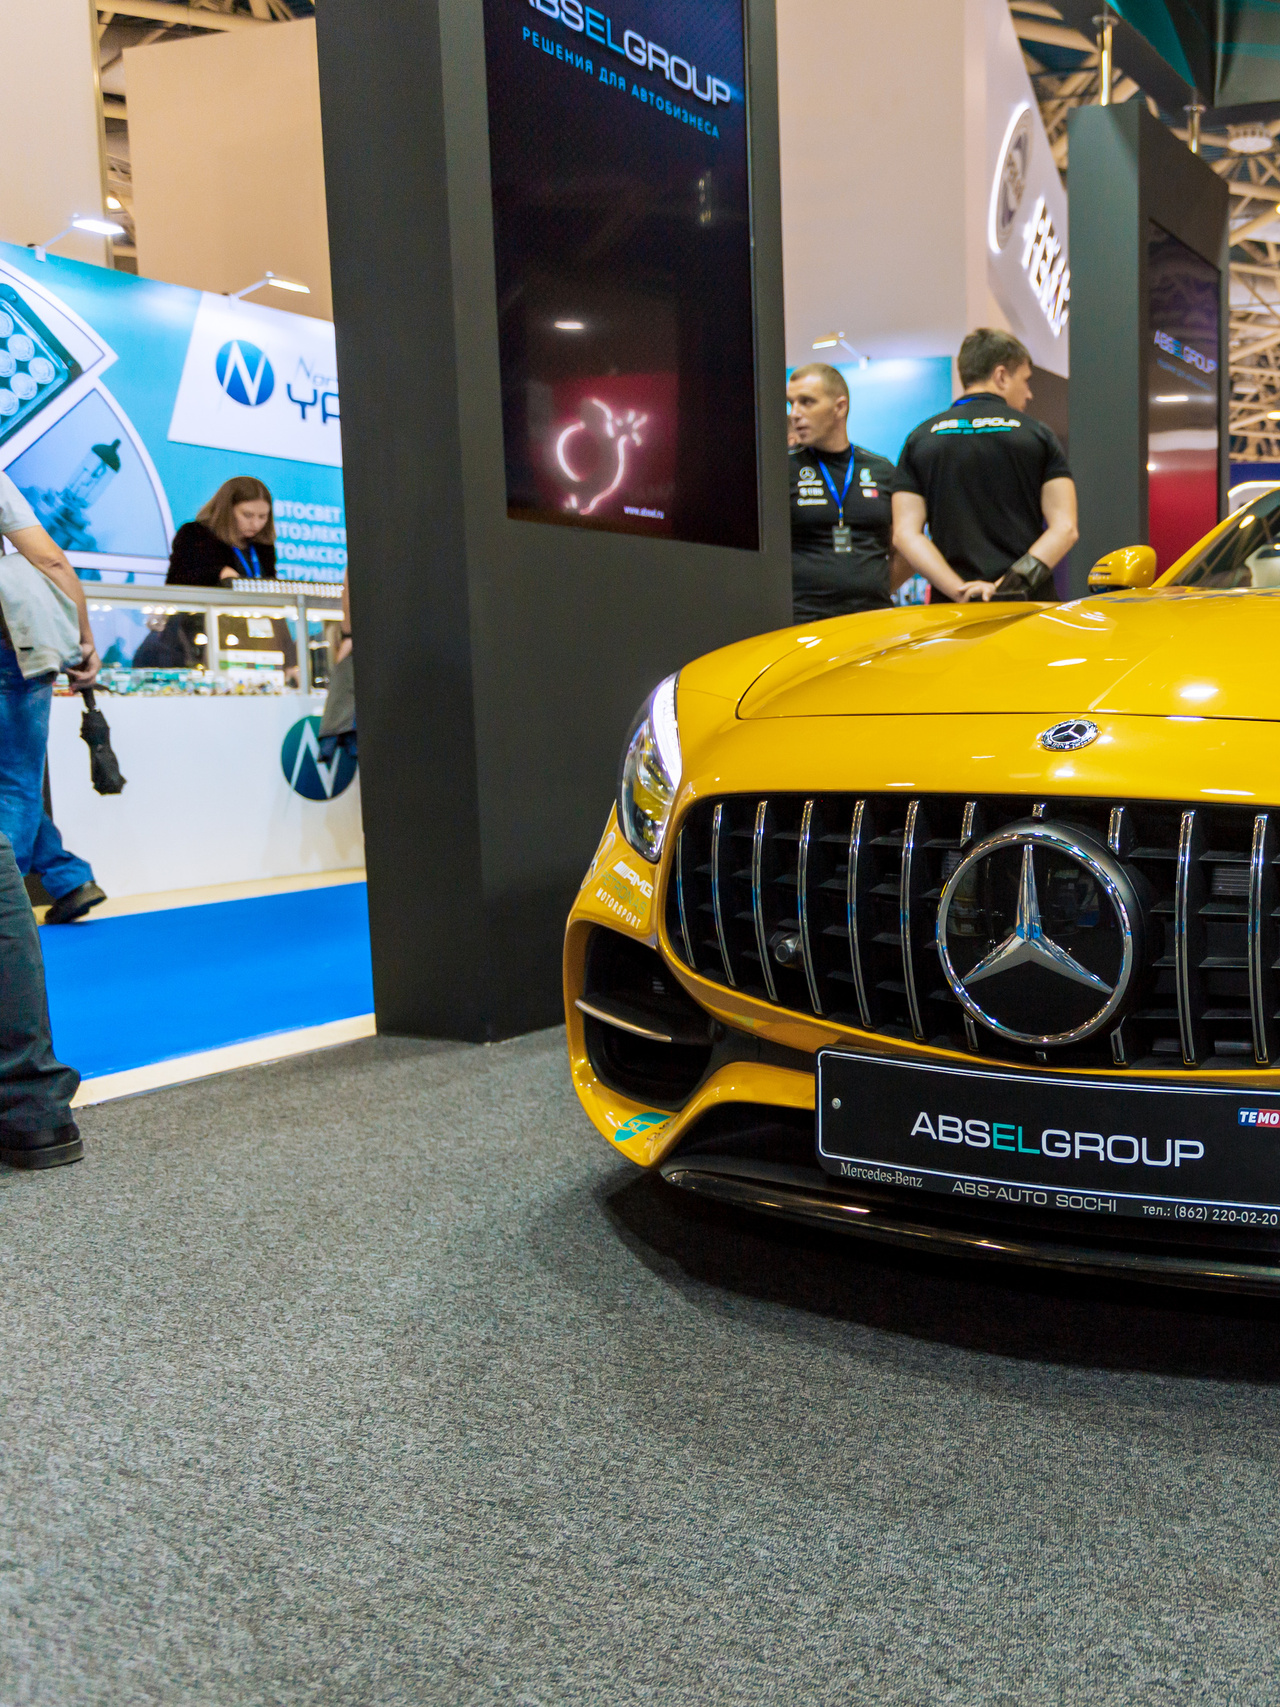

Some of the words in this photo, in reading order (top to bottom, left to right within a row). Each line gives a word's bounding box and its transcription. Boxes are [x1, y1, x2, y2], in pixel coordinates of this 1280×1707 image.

[528, 0, 731, 105] BSELGROUP
[522, 25, 593, 75] РЕШЕНИЯ
[599, 67, 626, 92] ДЛЯ
[631, 84, 720, 139] АВТОБИЗНЕСА
[273, 499, 341, 523] ВТОСВЕТ
[595, 887, 642, 930] MOTORSPORT
[910, 1112, 1205, 1168] ABSELGROUP
[840, 1162, 923, 1188] Mercedes-Benz
[952, 1180, 1047, 1206] ABS-AUTO
[1055, 1194, 1117, 1213] SOCHI
[1142, 1205, 1171, 1217] тел.:
[1174, 1204, 1208, 1222] (862)
[1212, 1208, 1278, 1226] 220-02-20
